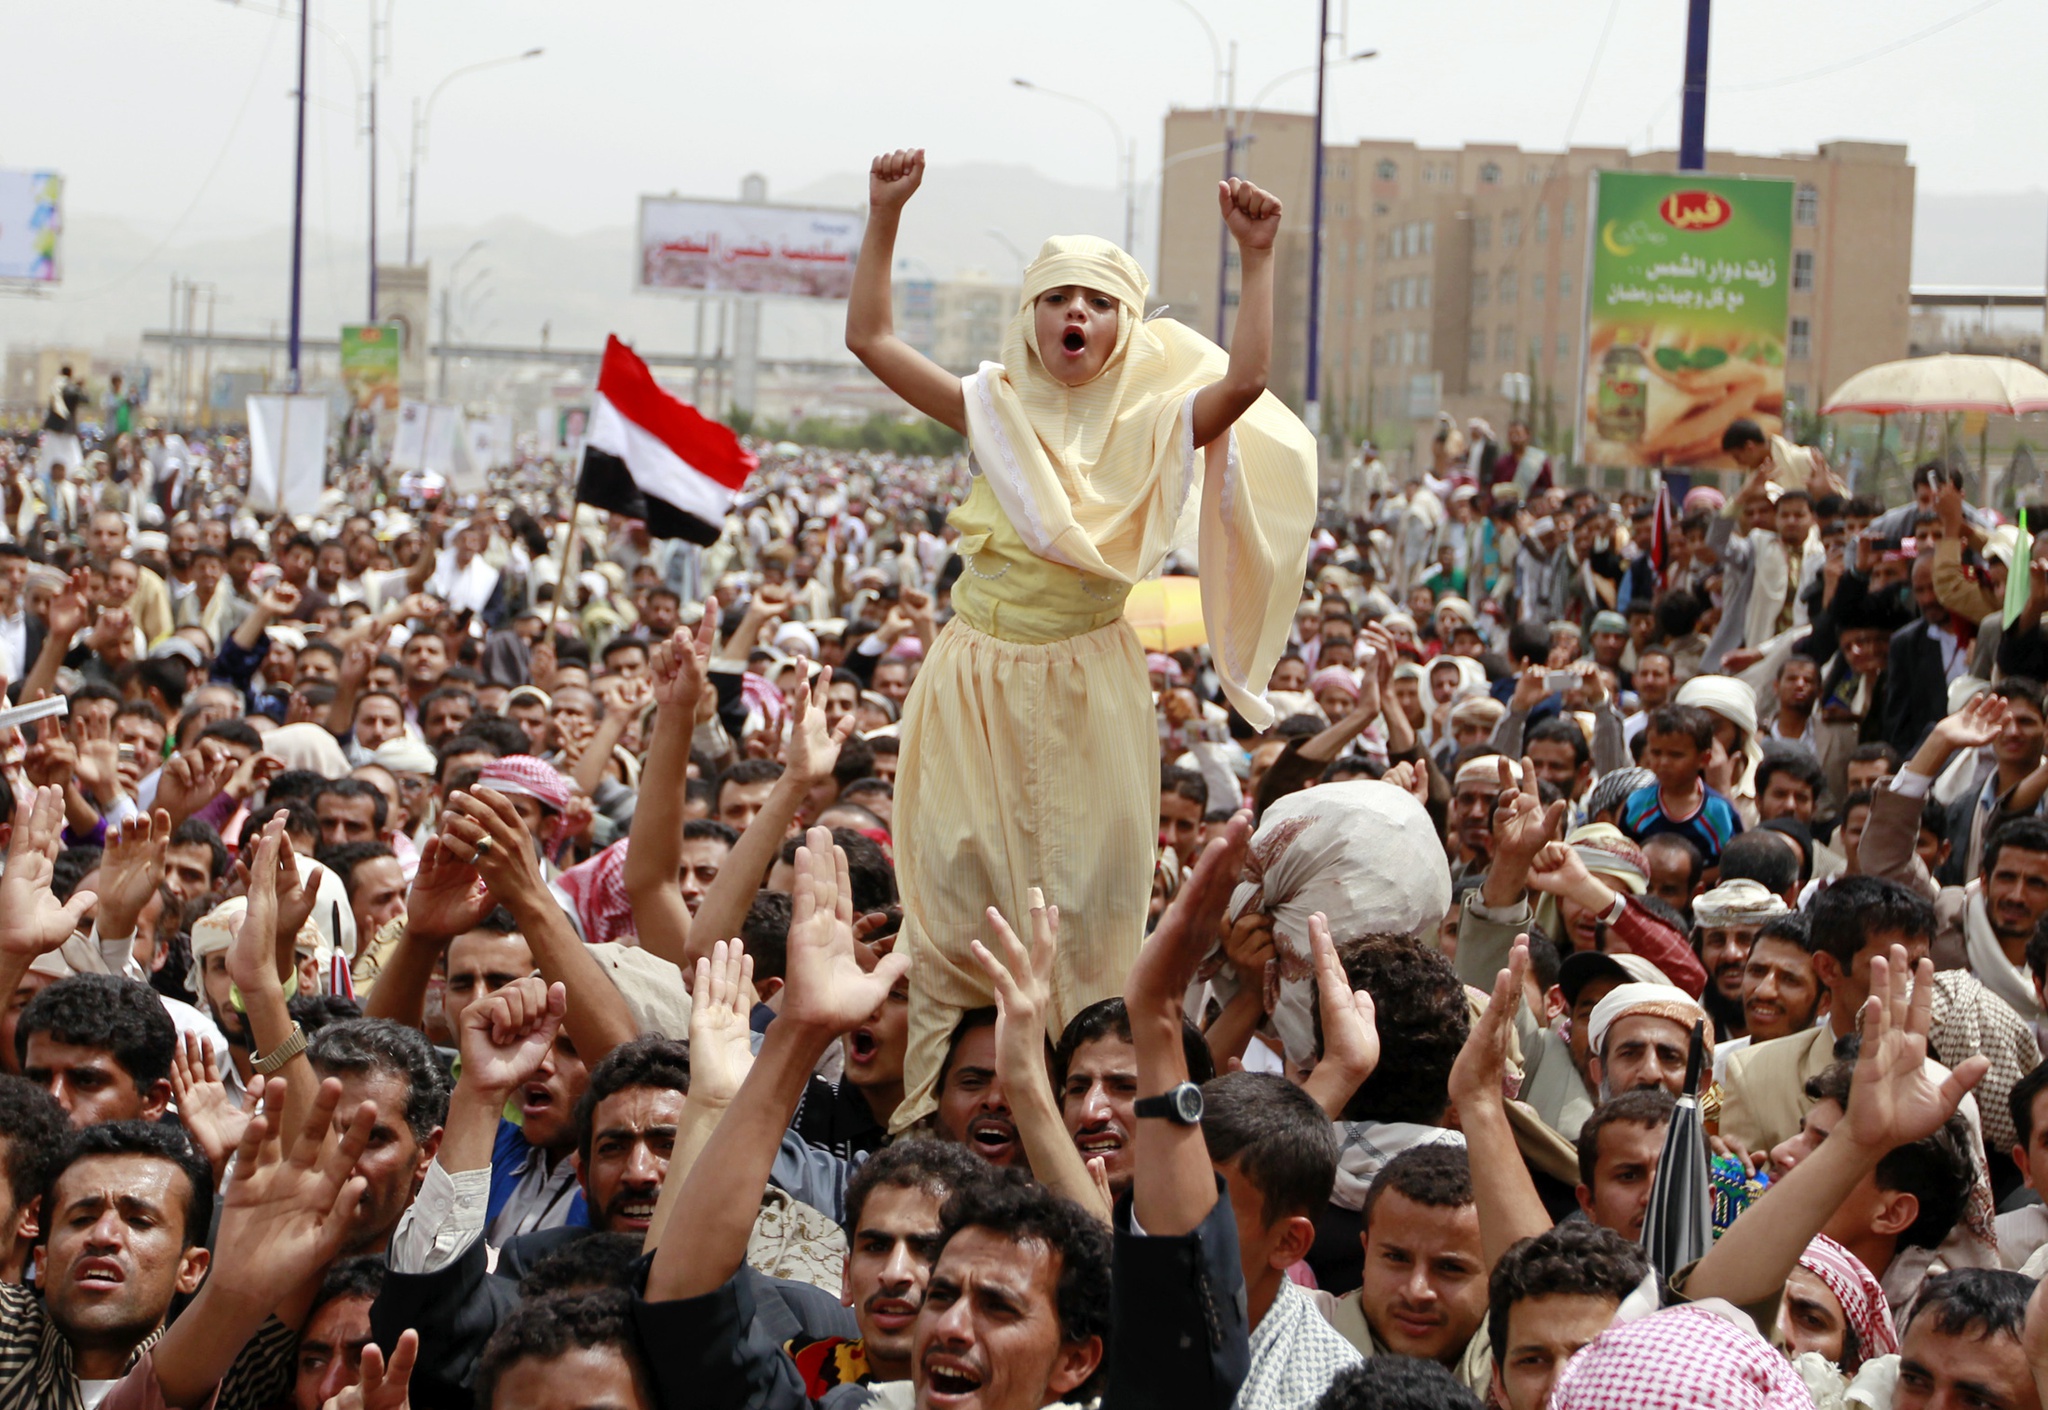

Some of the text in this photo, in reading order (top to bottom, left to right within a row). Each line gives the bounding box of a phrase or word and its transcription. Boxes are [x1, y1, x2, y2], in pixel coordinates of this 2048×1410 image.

[1646, 252, 1706, 281] الشمس
[1707, 258, 1742, 284] دوار
[1744, 258, 1777, 288] زيت
[1606, 283, 1744, 313] مع كل وجبات رمضان
